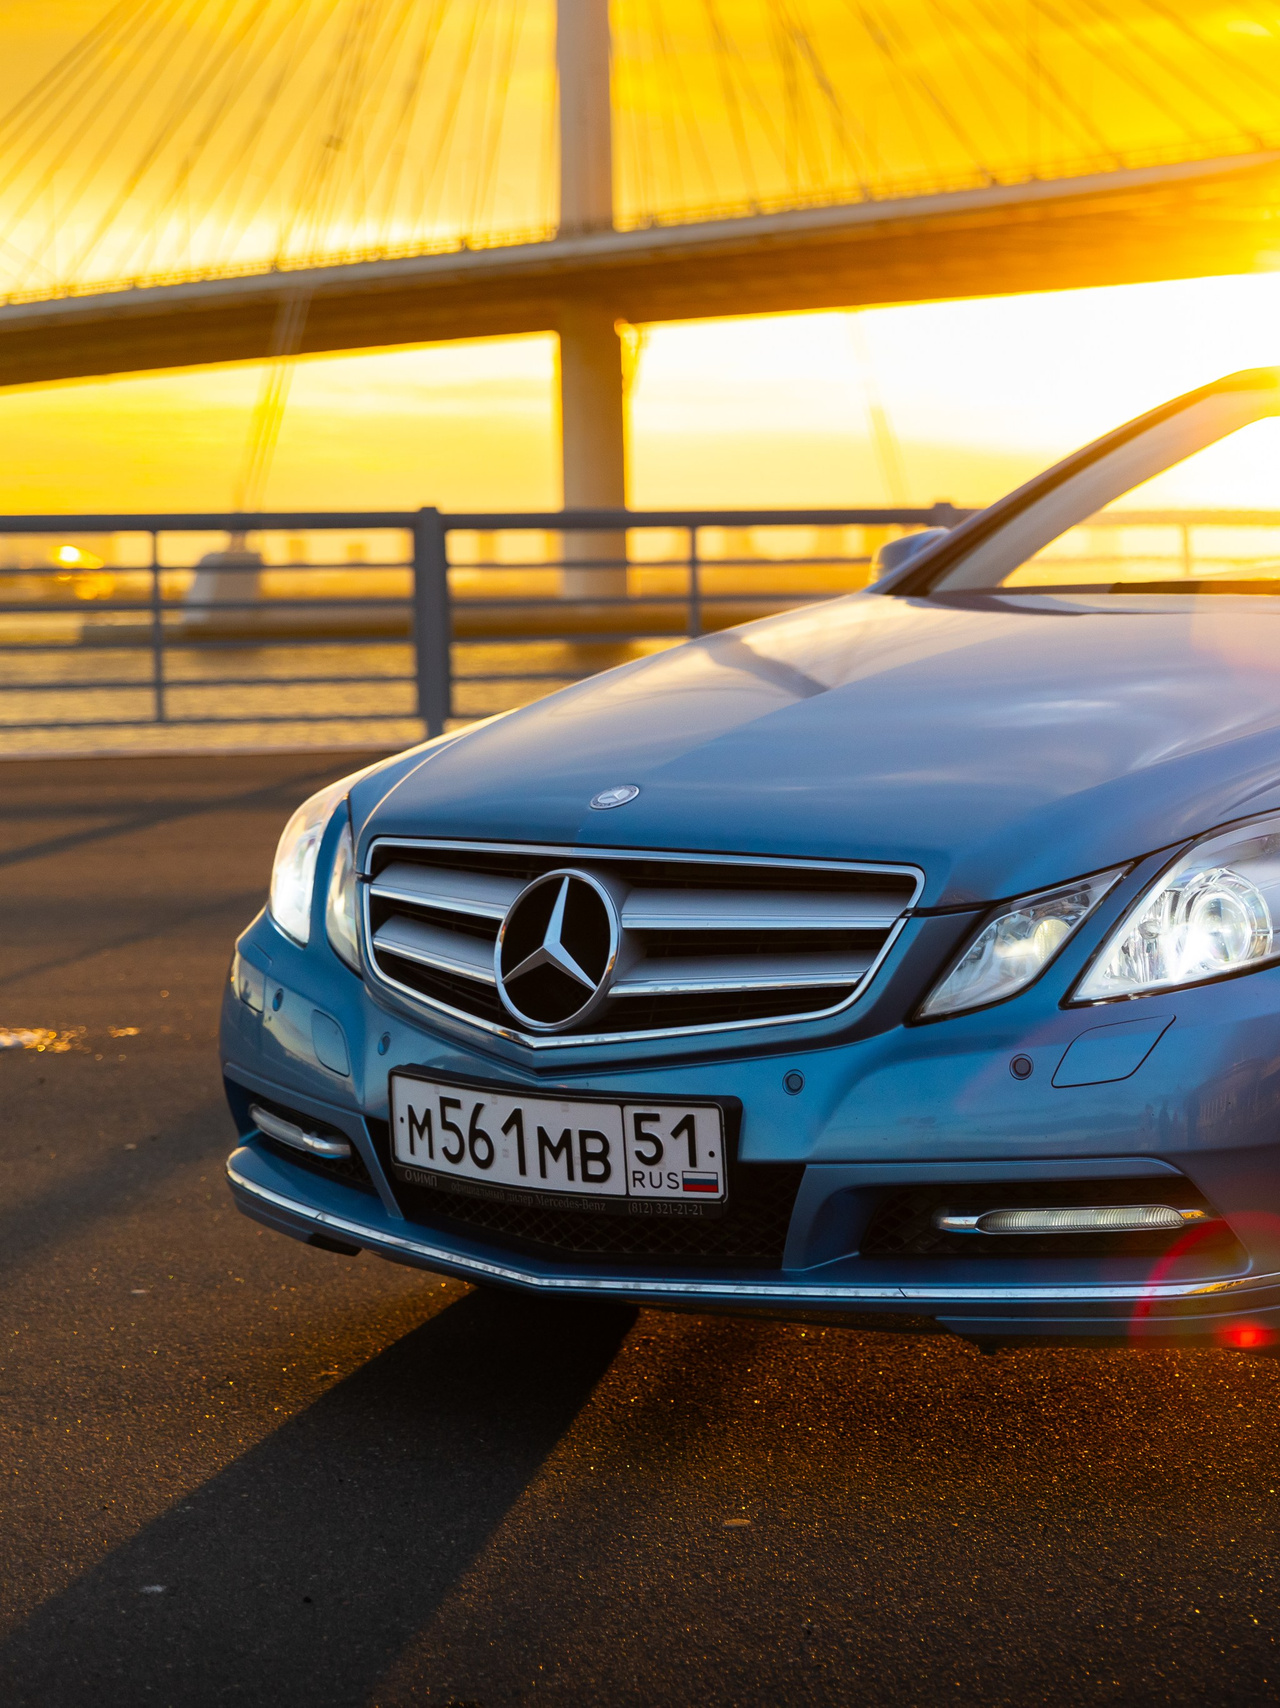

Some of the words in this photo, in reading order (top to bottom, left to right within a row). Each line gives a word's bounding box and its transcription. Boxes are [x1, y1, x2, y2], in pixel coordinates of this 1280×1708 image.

[633, 1112, 698, 1168] 51
[404, 1169, 438, 1187] ОЛИМП
[632, 1170, 680, 1190] RUS
[535, 1194, 607, 1212] Mercedes-Benz
[628, 1201, 654, 1216] (812)
[656, 1203, 704, 1216] 321-21-21
